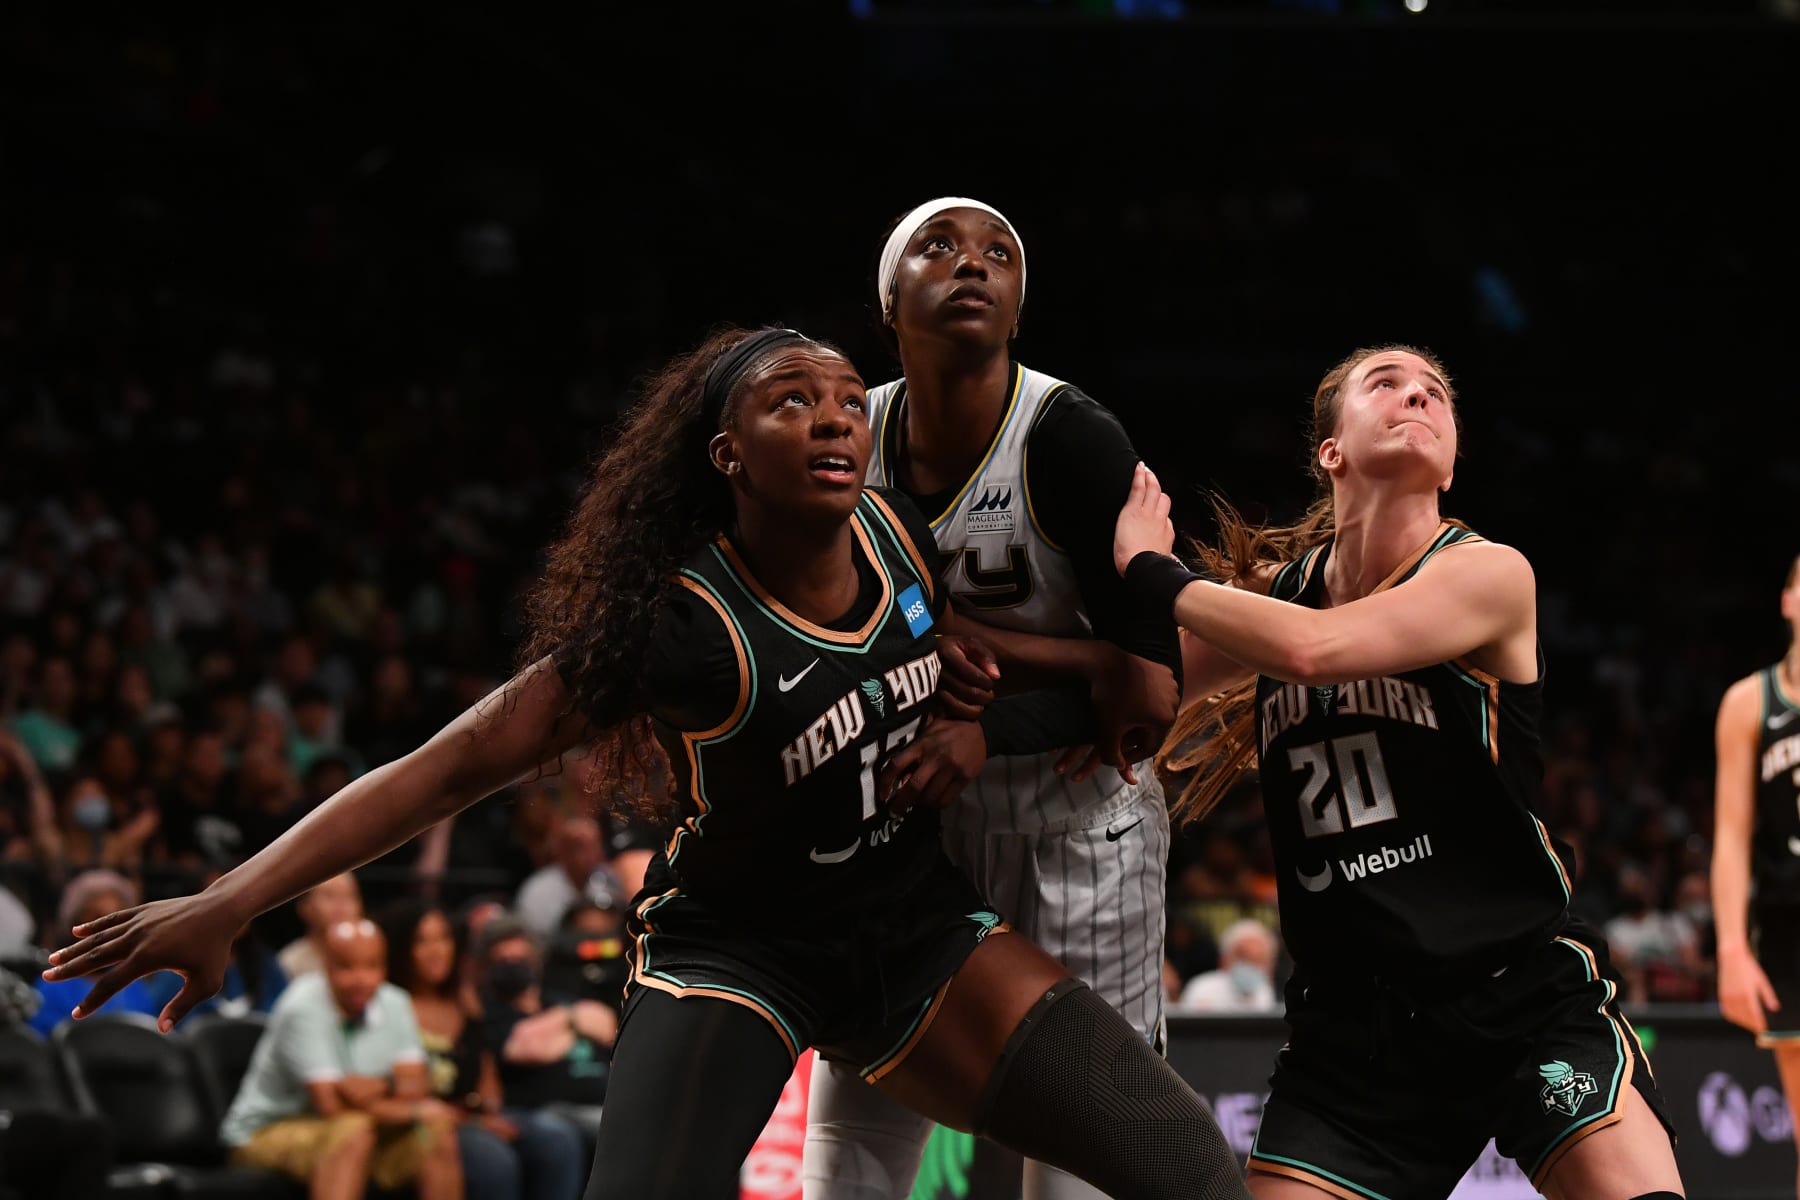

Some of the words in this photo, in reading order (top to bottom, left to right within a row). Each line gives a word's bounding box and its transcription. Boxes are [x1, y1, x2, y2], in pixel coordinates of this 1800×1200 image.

[967, 514, 1013, 523] MAGELLAN
[905, 600, 925, 624] HSS
[1336, 675, 1440, 731] YORK
[779, 688, 866, 789] NEW
[1286, 730, 1399, 839] 20
[1338, 833, 1433, 882] Webull
